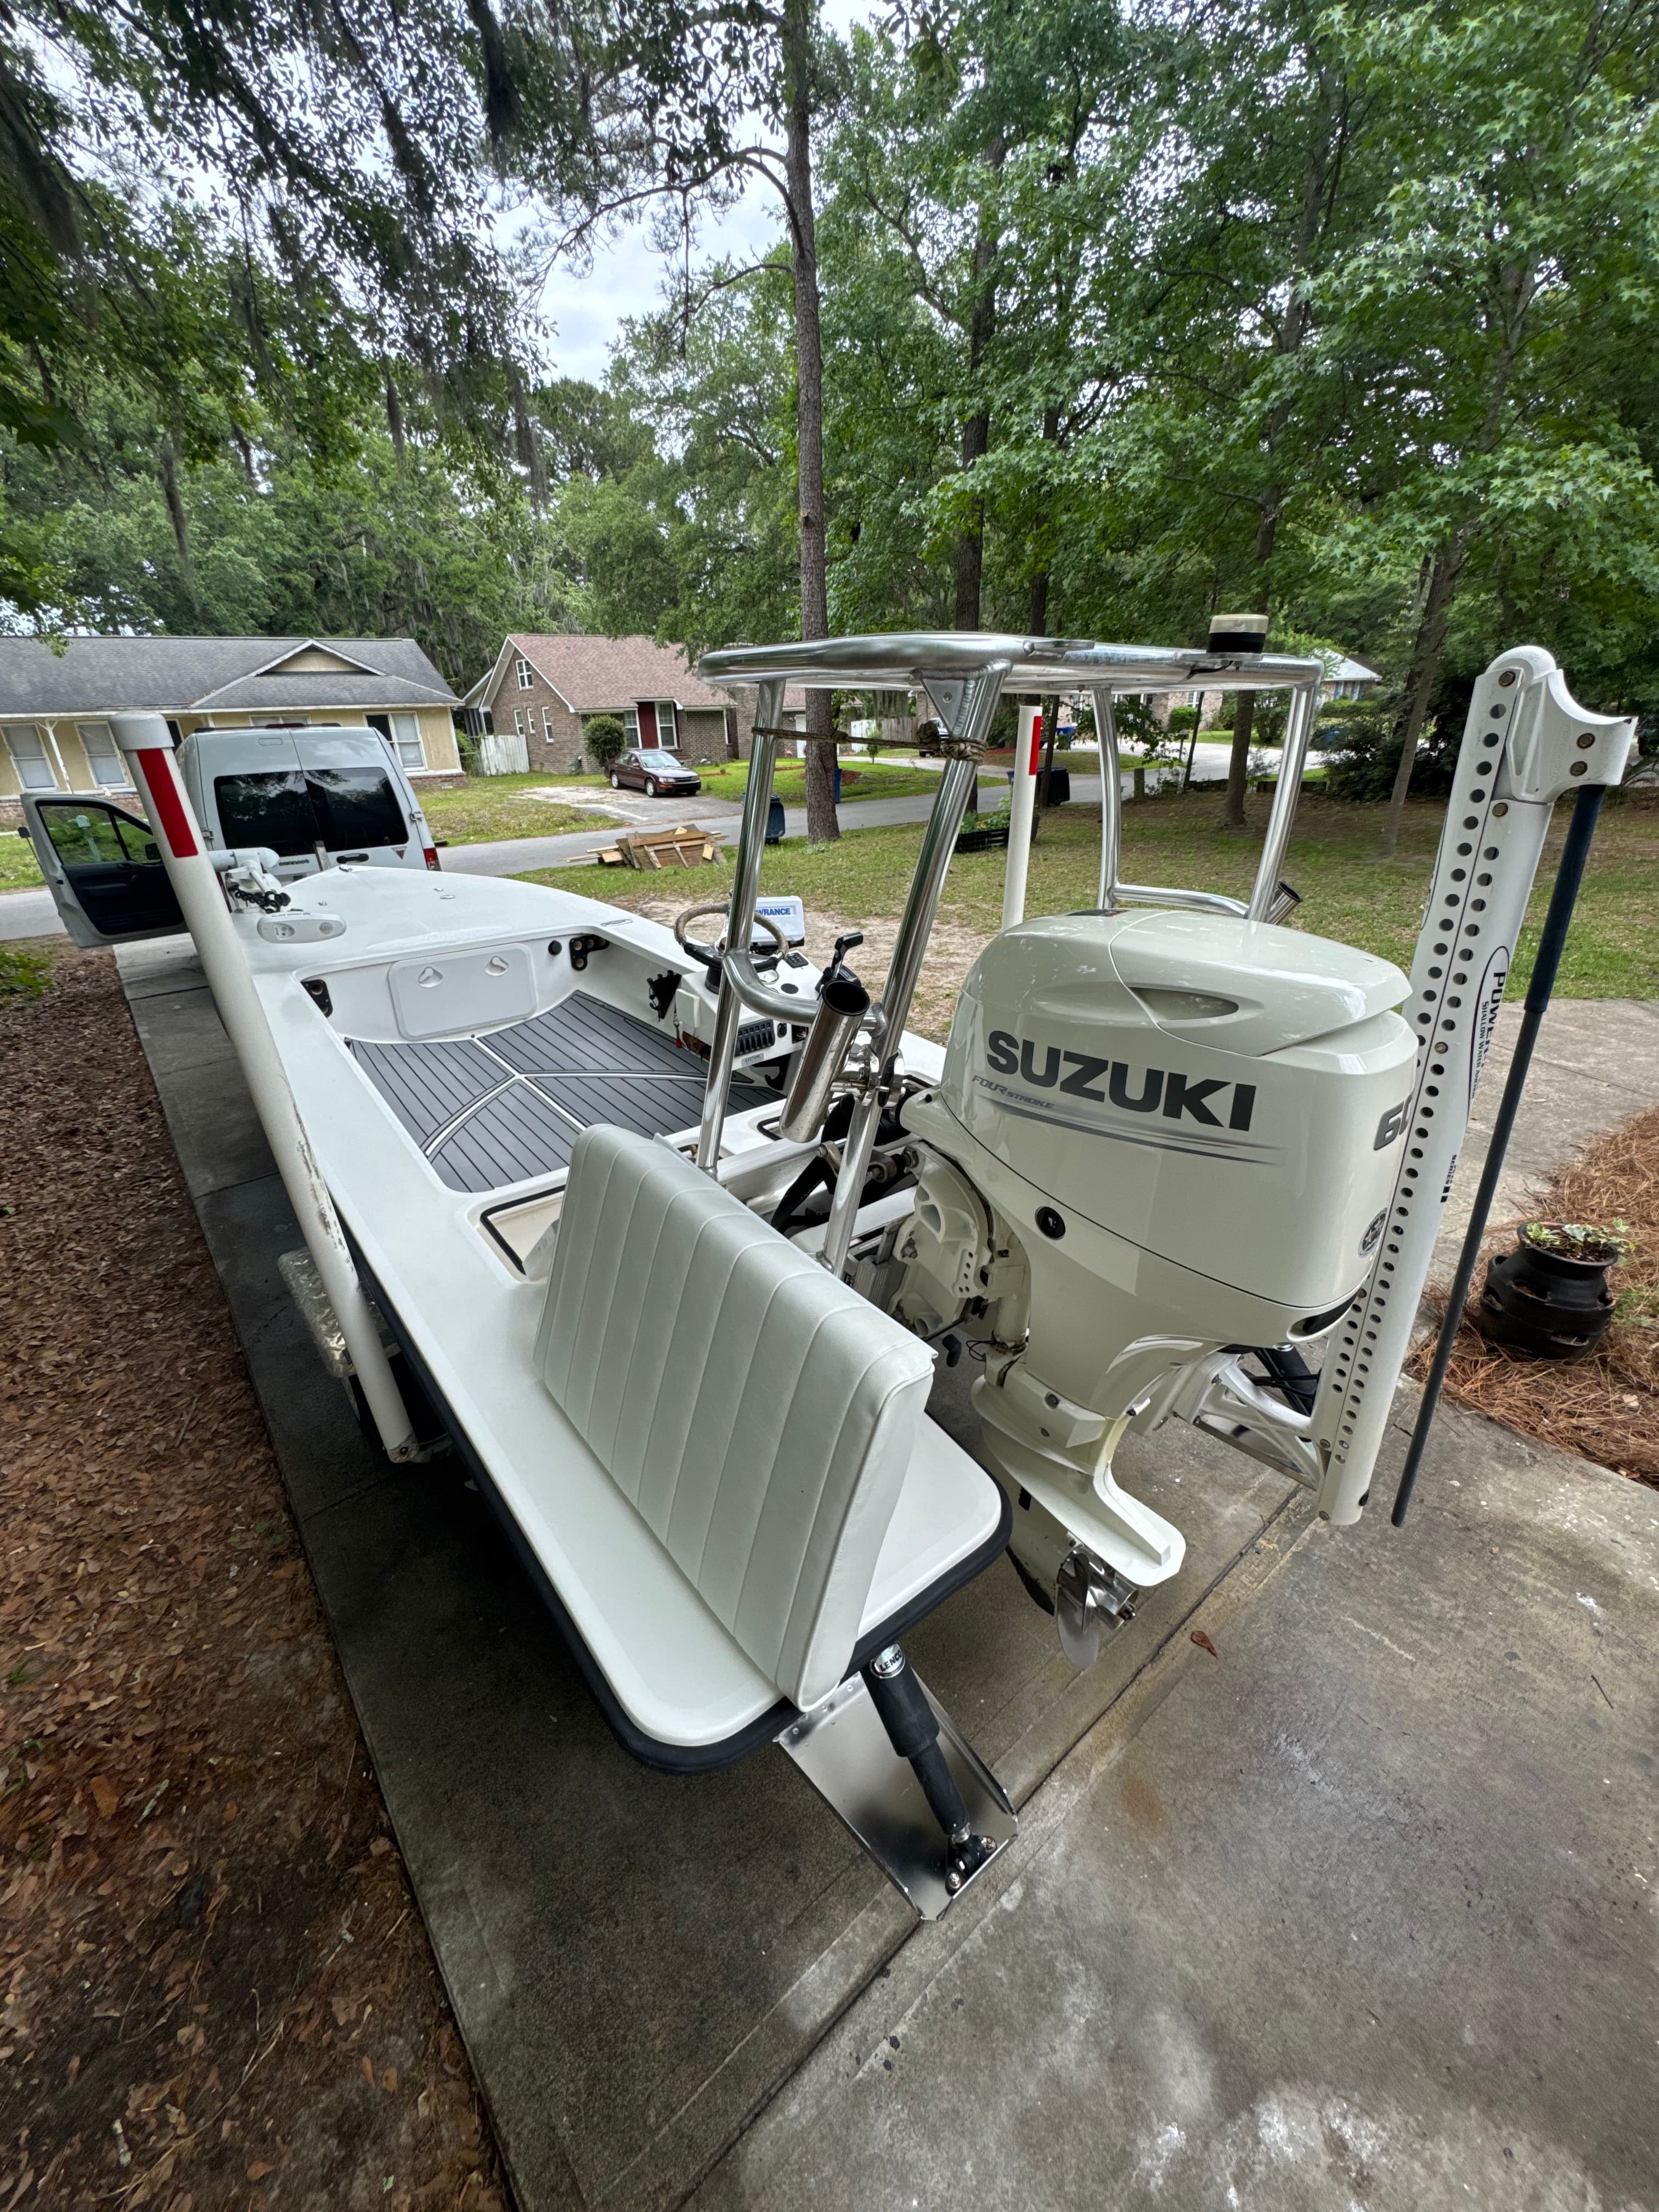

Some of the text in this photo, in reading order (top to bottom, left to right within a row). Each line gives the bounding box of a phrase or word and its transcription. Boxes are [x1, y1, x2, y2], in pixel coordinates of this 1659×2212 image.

[971, 1075, 1055, 1109] FOUR STROKE
[987, 1030, 1257, 1131] SUZUKI
[879, 1650, 902, 1672] LENCO
